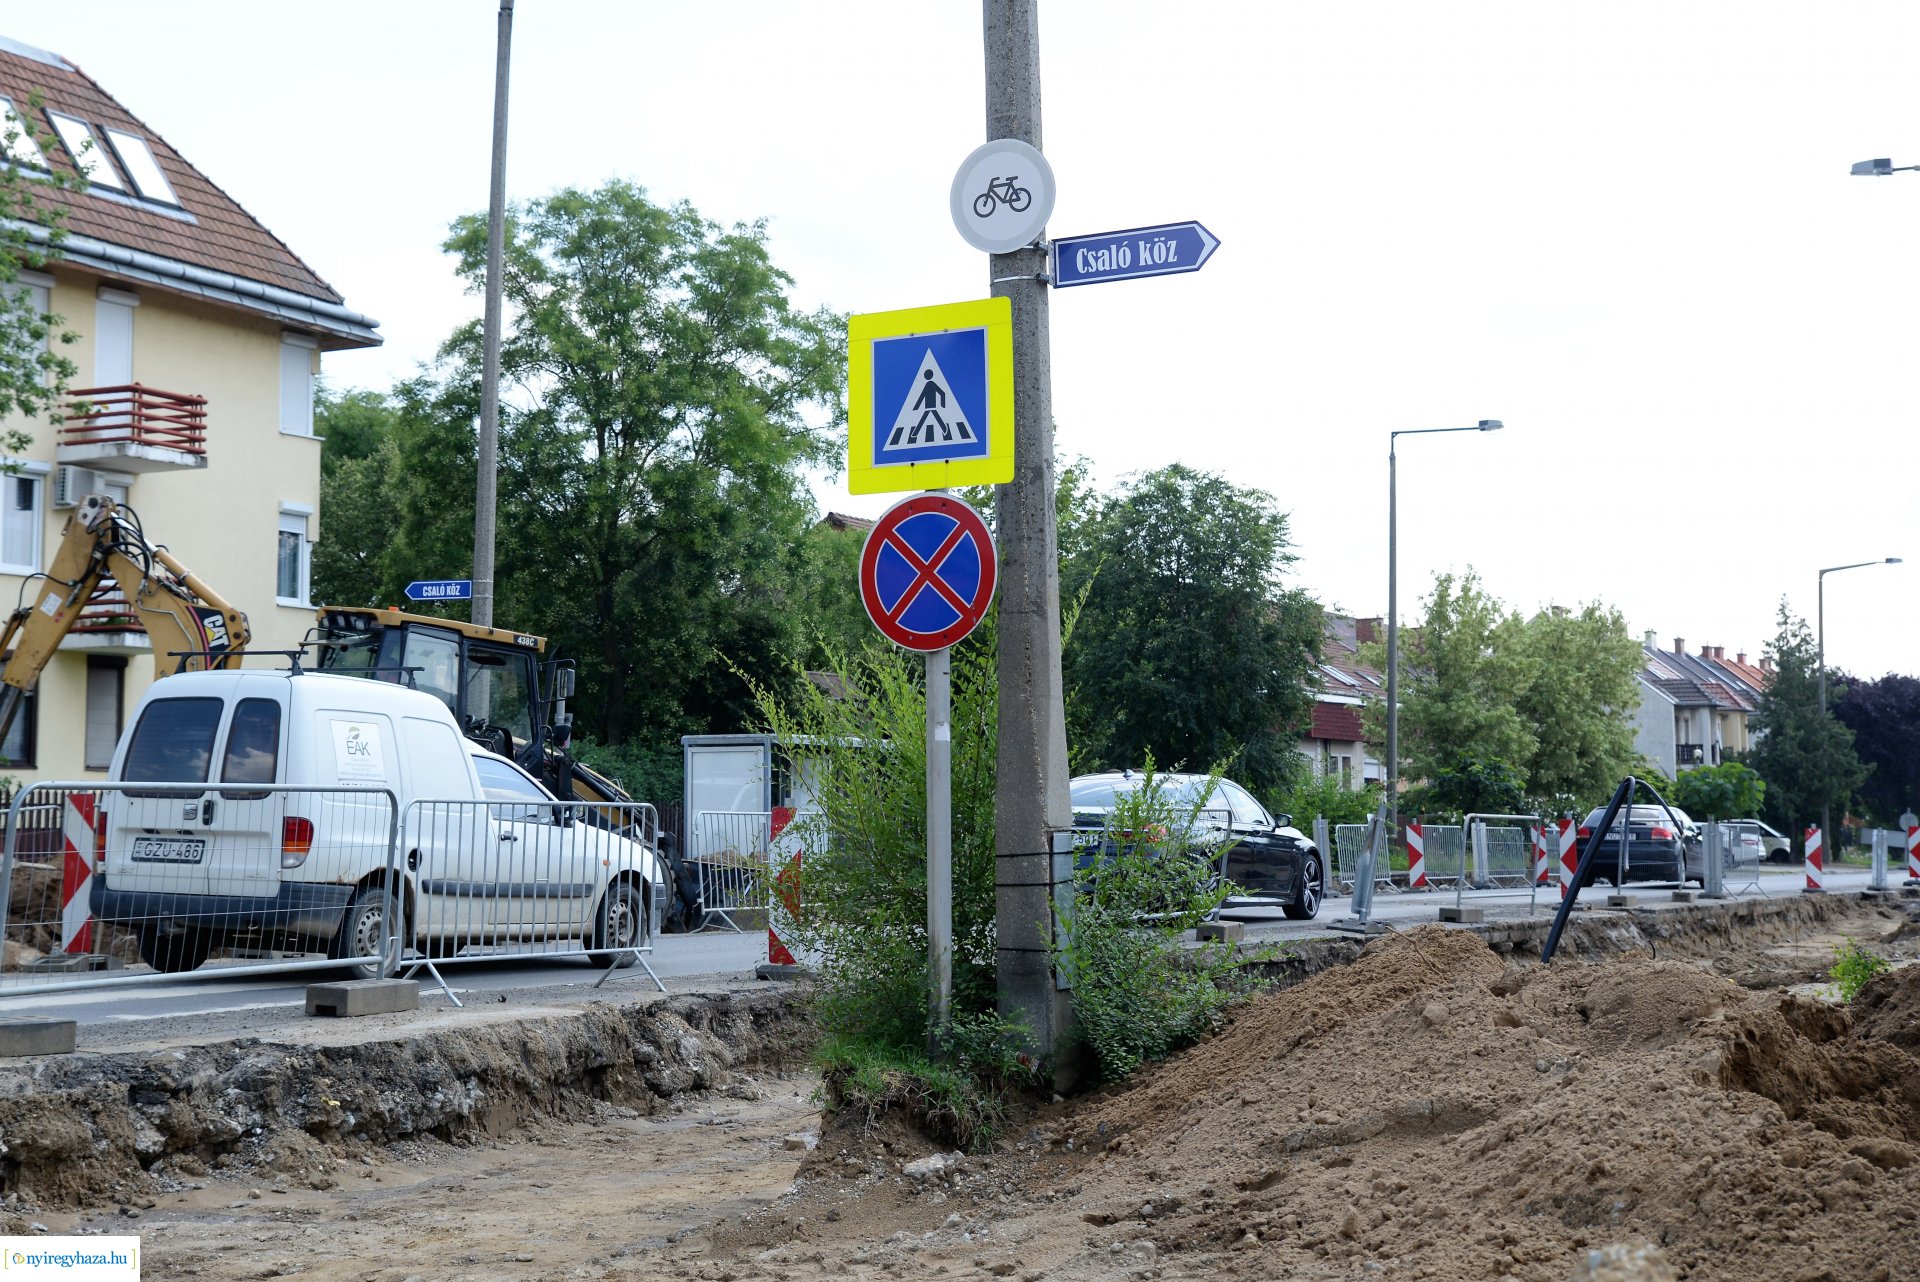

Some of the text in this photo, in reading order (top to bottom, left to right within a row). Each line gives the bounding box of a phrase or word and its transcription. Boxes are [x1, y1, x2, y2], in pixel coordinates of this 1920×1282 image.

[1076, 236, 1178, 274] Csaló köz
[422, 583, 461, 597] CSALÓ KÖZ
[203, 614, 230, 648] CAT
[517, 636, 535, 646] 438C
[346, 740, 371, 756] EAK
[144, 842, 200, 859] GZU-486
